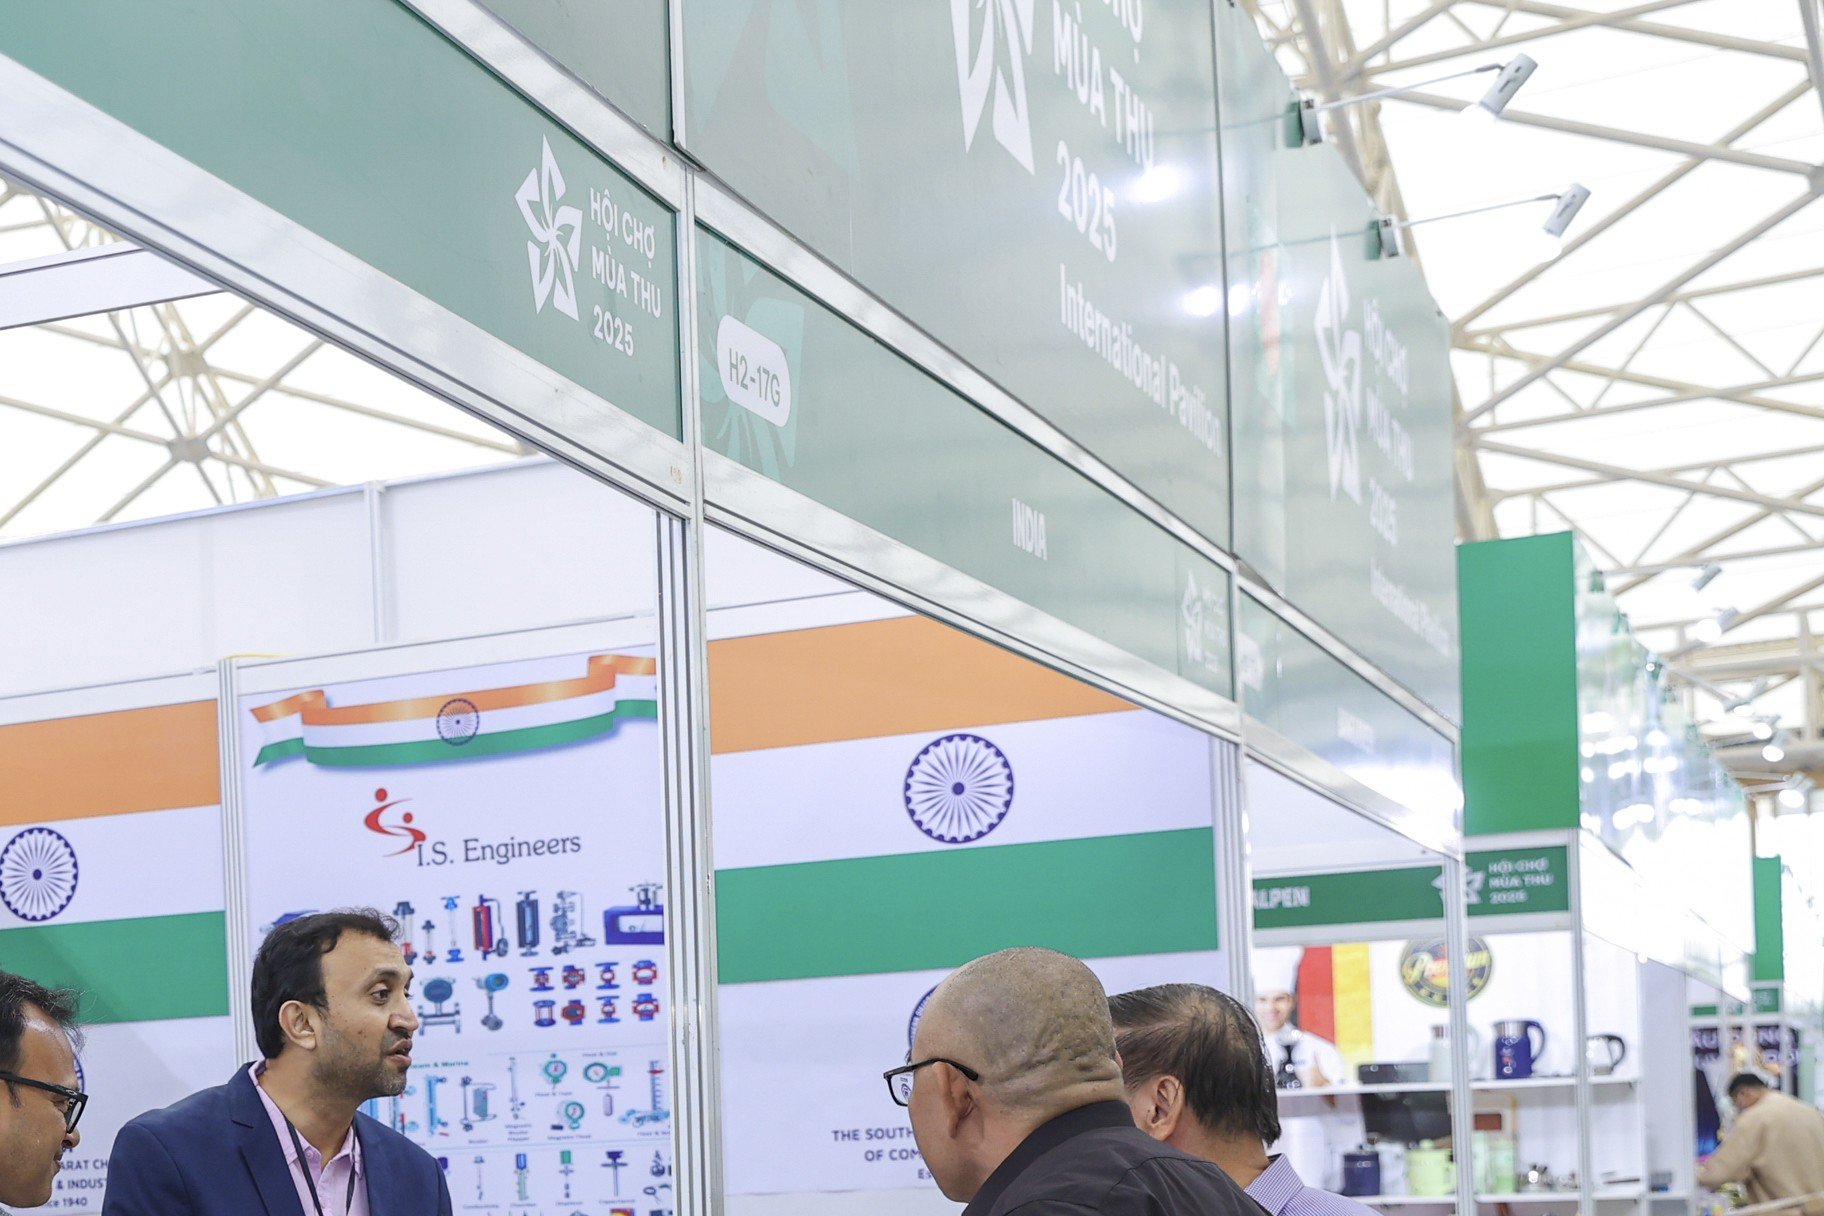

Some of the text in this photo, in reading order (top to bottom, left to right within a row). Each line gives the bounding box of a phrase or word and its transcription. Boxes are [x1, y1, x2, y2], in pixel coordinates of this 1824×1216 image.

[1109, 66, 1155, 171] THU
[590, 188, 656, 269] HỘI CHỢ
[1056, 140, 1117, 263] 2025
[591, 244, 661, 318] MÙA THU
[594, 304, 634, 357] 2025
[729, 348, 780, 408] H2-17G
[1060, 262, 1222, 458] International Pavilion
[1012, 497, 1047, 560] INDIA
[417, 835, 582, 867] I.S. Engineers
[1523, 871, 1554, 886] THU
[1489, 889, 1528, 904] 2025
[832, 1129, 860, 1141] THE
[865, 1148, 921, 1161] OF COM
[56, 1181, 64, 1189] &
